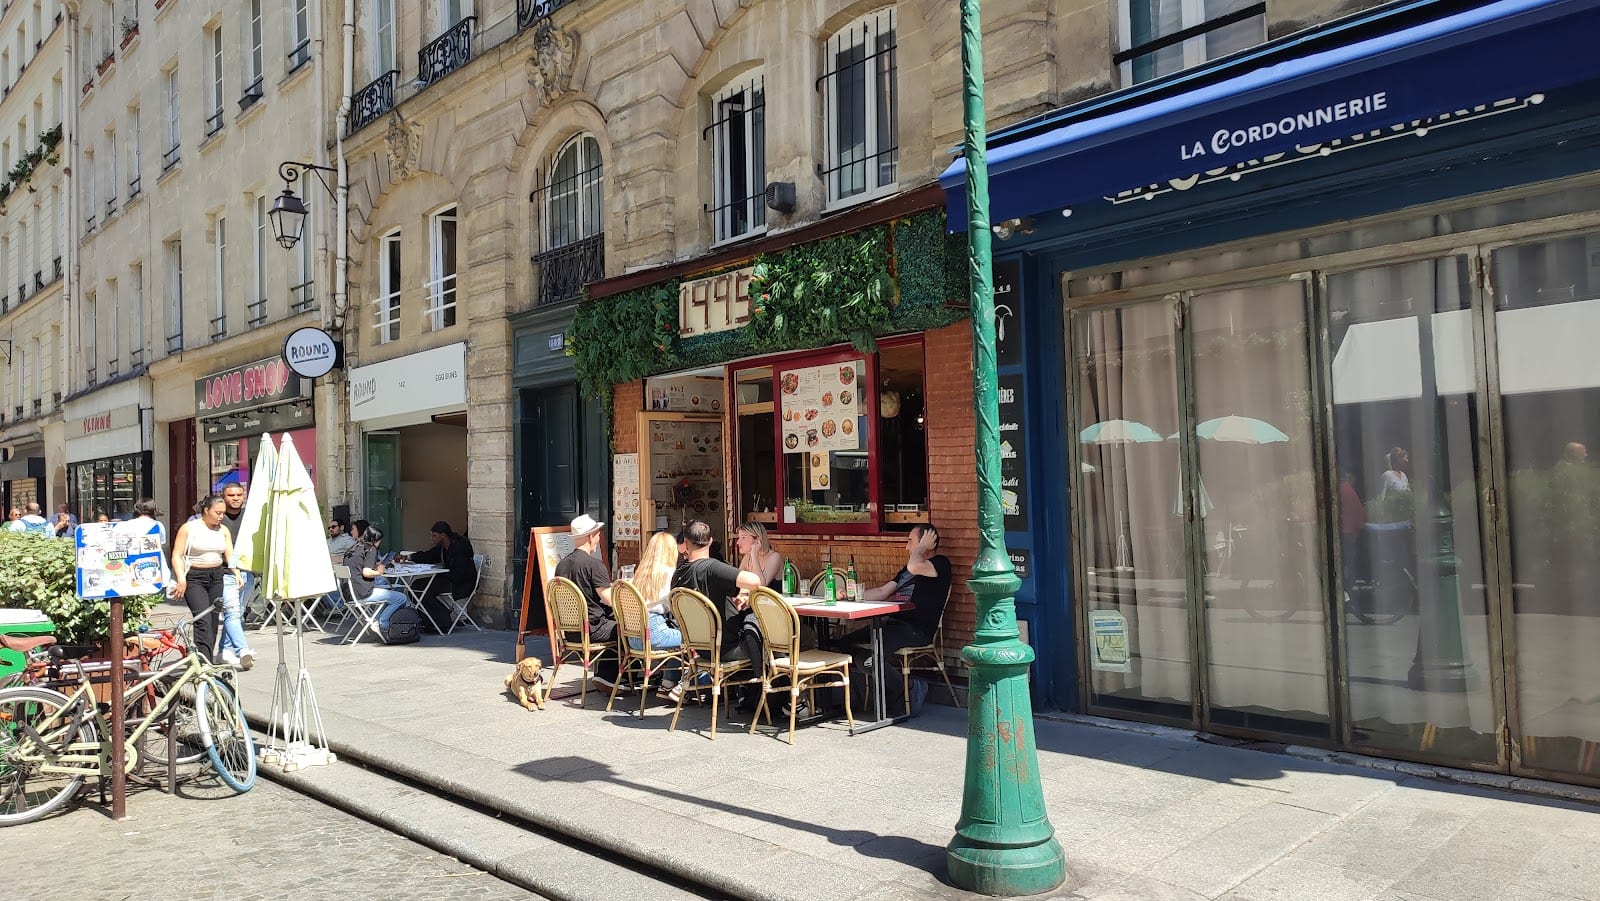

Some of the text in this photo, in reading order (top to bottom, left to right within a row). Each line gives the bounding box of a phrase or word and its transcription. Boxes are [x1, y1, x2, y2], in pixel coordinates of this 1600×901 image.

[1180, 140, 1206, 161] LA
[1210, 91, 1388, 155] CORDONNERIE
[678, 271, 754, 336] 1995
[291, 342, 330, 360] ROUND
[205, 371, 242, 410] LOVE
[243, 358, 290, 401] SHOP
[353, 377, 377, 401] ROUND
